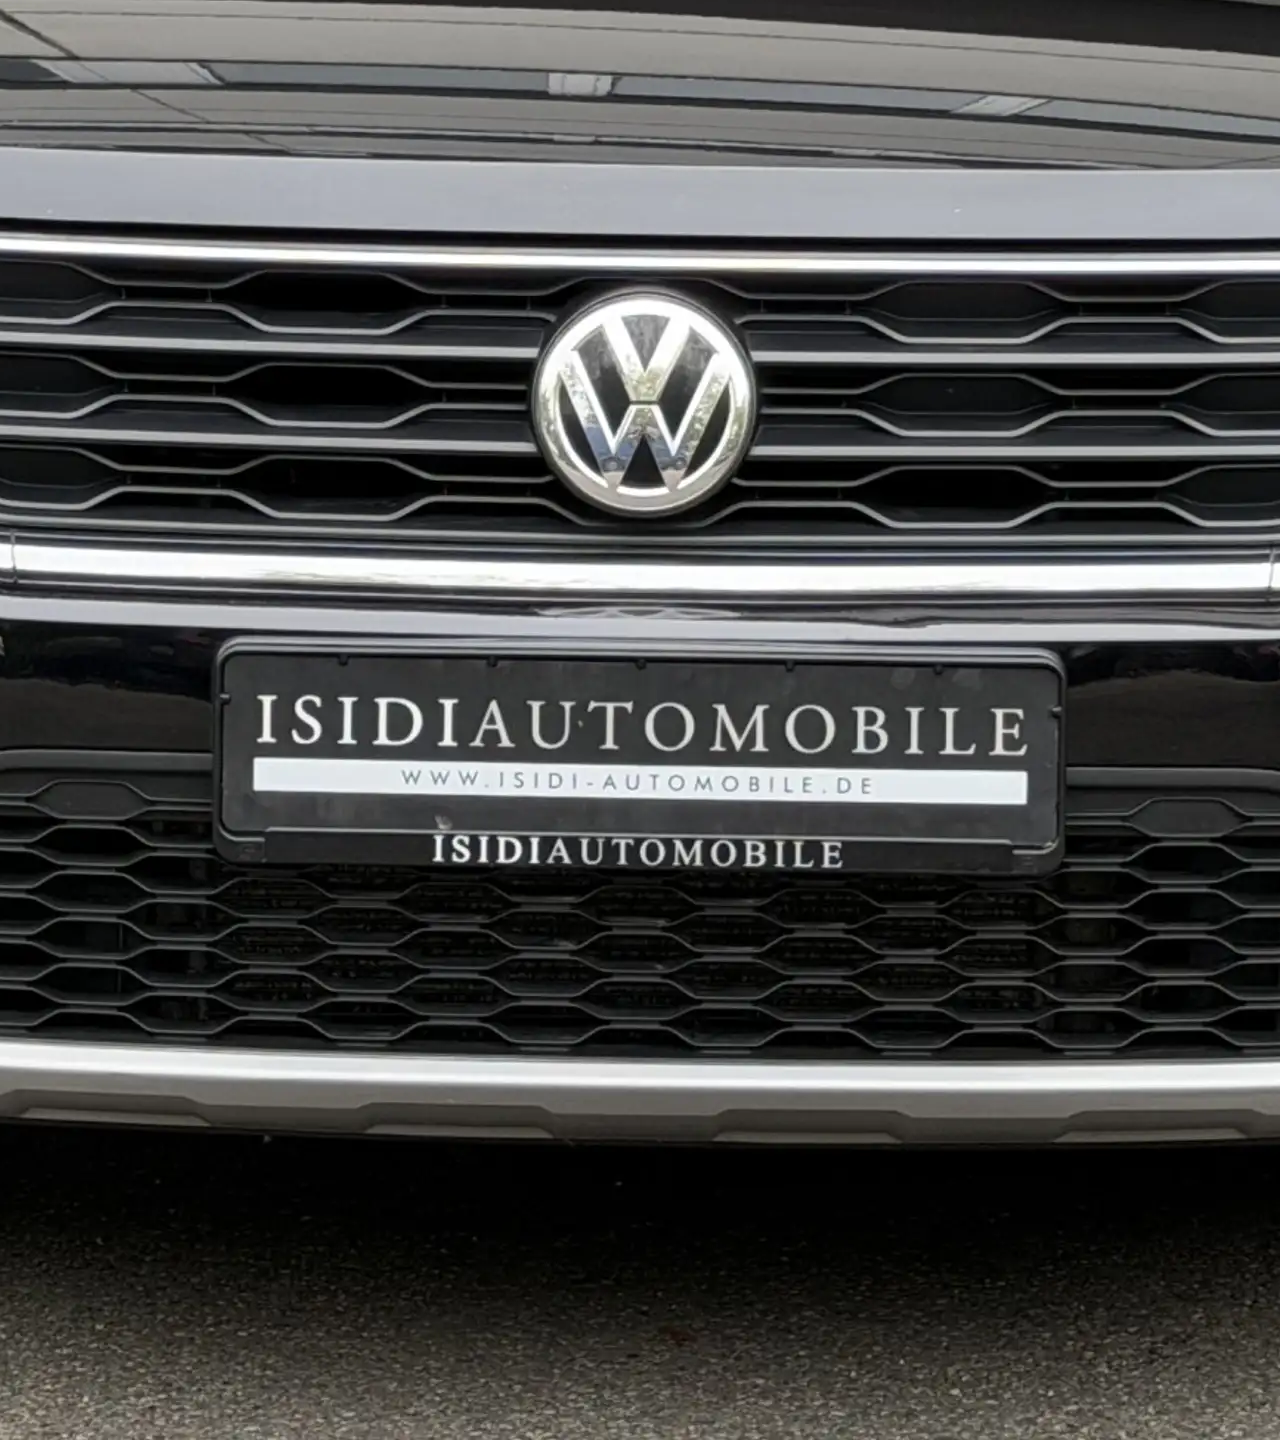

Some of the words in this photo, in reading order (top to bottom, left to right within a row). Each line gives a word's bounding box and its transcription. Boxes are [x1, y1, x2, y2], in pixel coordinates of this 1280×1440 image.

[256, 694, 1029, 757] ISIDIAUTOMOBILE
[400, 768, 873, 795] WWW.ISIDI-AUTOMOBILE.DE
[432, 833, 844, 869] ISIDIAUTOMOBILE
